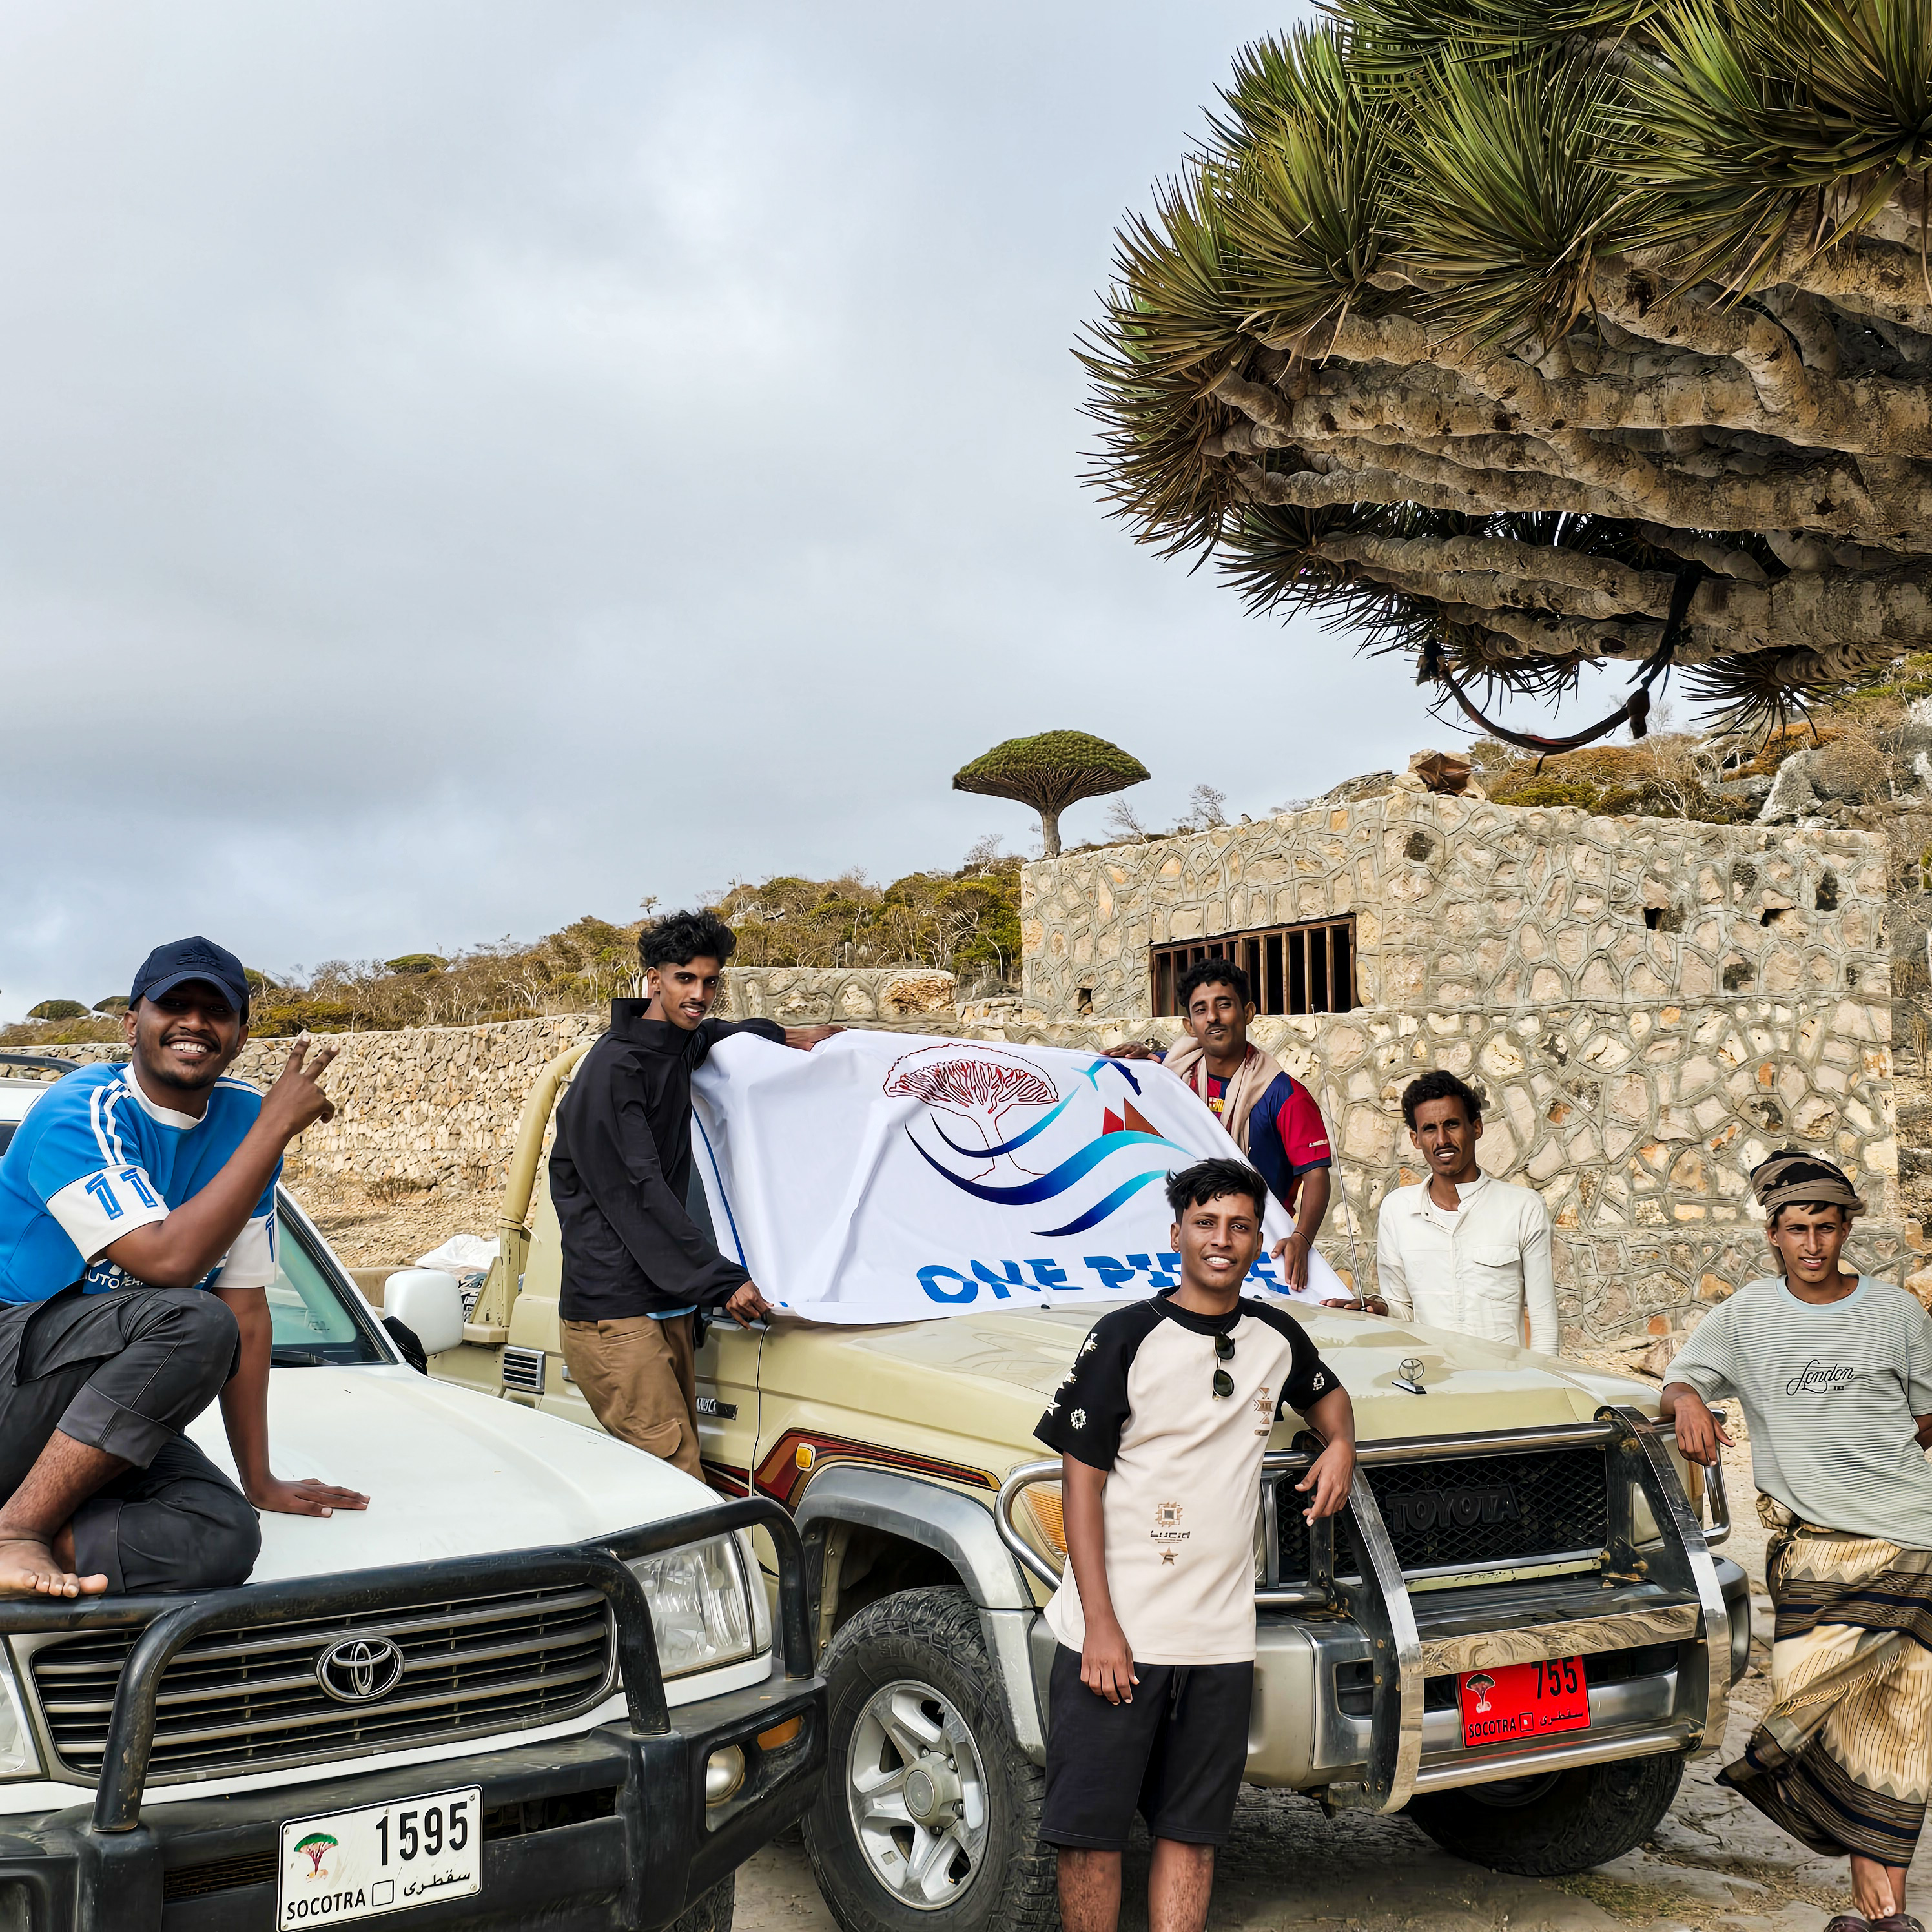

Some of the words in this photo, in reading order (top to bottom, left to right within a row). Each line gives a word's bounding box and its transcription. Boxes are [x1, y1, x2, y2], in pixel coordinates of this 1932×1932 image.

[85, 1168, 158, 1220] 11
[85, 1269, 120, 1290] UTO
[916, 1258, 1084, 1303] ONE
[1786, 1359, 1855, 1396] London
[1386, 1485, 1521, 1534] TOYOTA
[1530, 1656, 1577, 1700] 755
[1468, 1718, 1516, 1738] SOCOTRA
[376, 1801, 468, 1866] 1595
[286, 1888, 365, 1920] SOCOTRA
